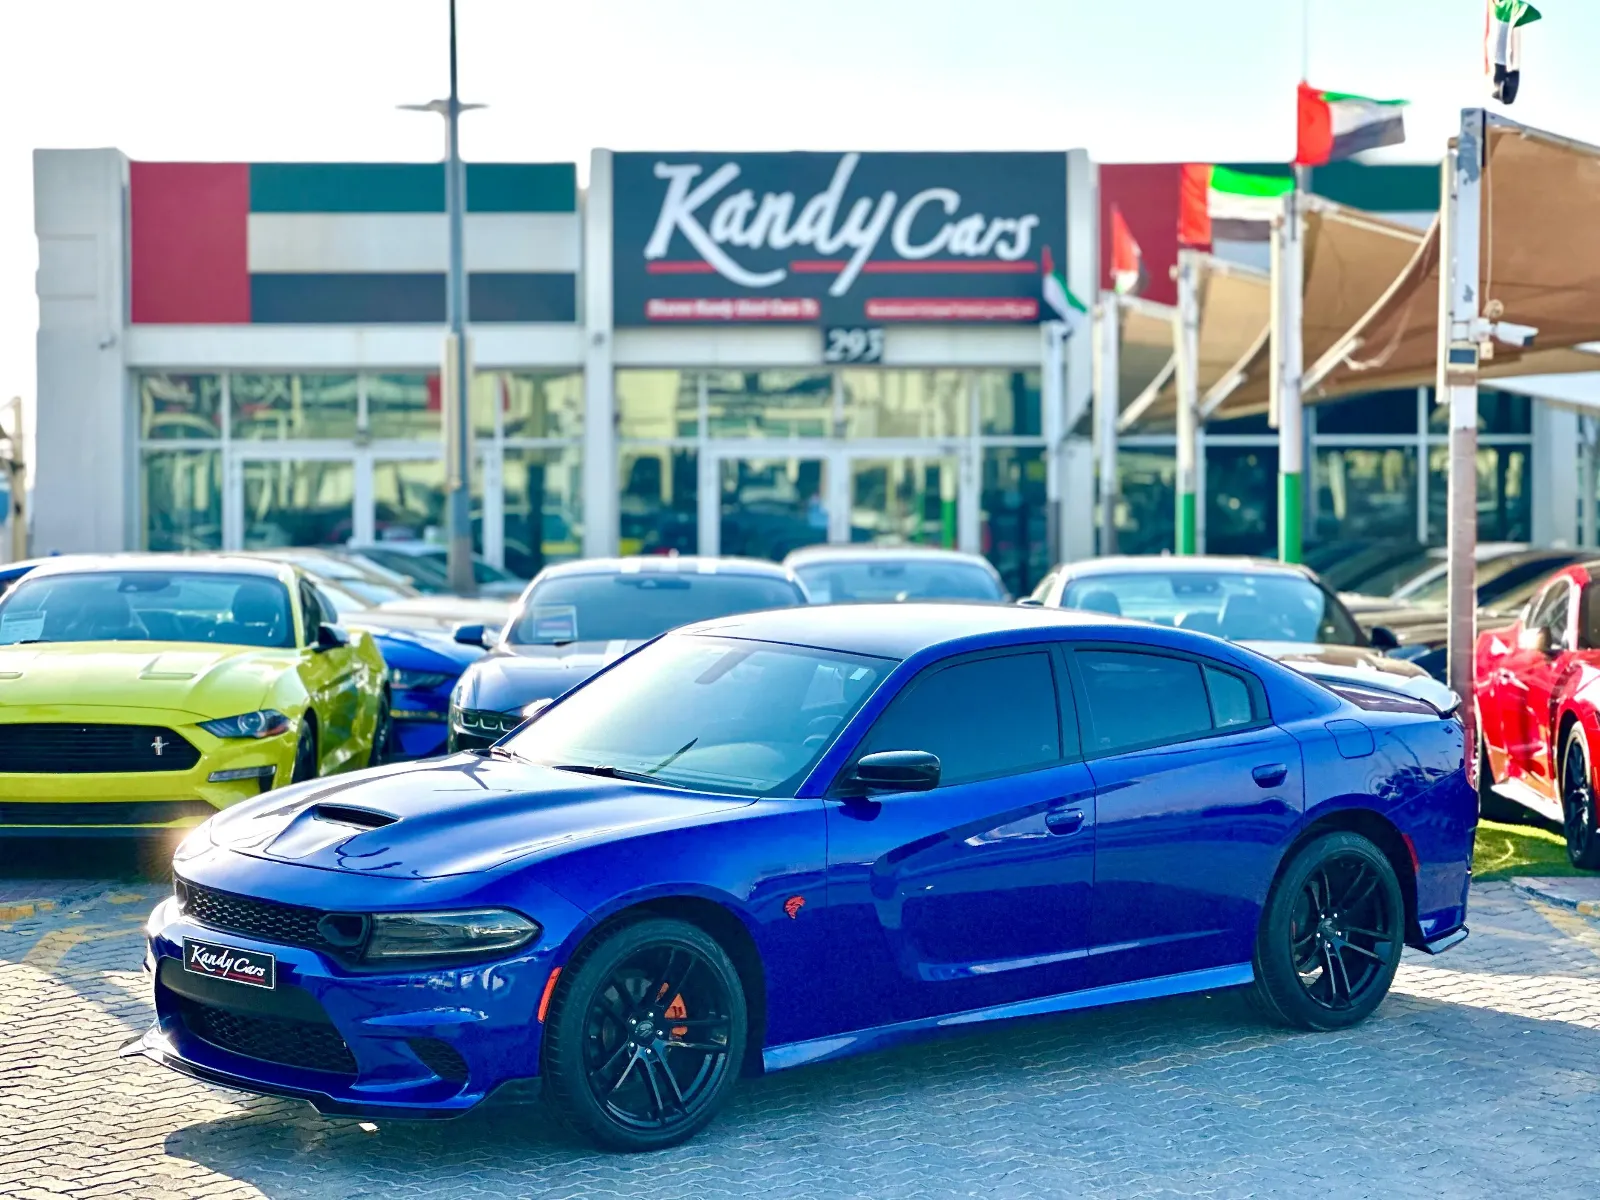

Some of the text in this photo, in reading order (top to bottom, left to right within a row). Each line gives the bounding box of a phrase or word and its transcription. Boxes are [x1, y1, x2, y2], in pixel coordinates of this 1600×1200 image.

[644, 152, 1040, 297] Kandy Cars
[190, 944, 266, 977] Kandy Cars
